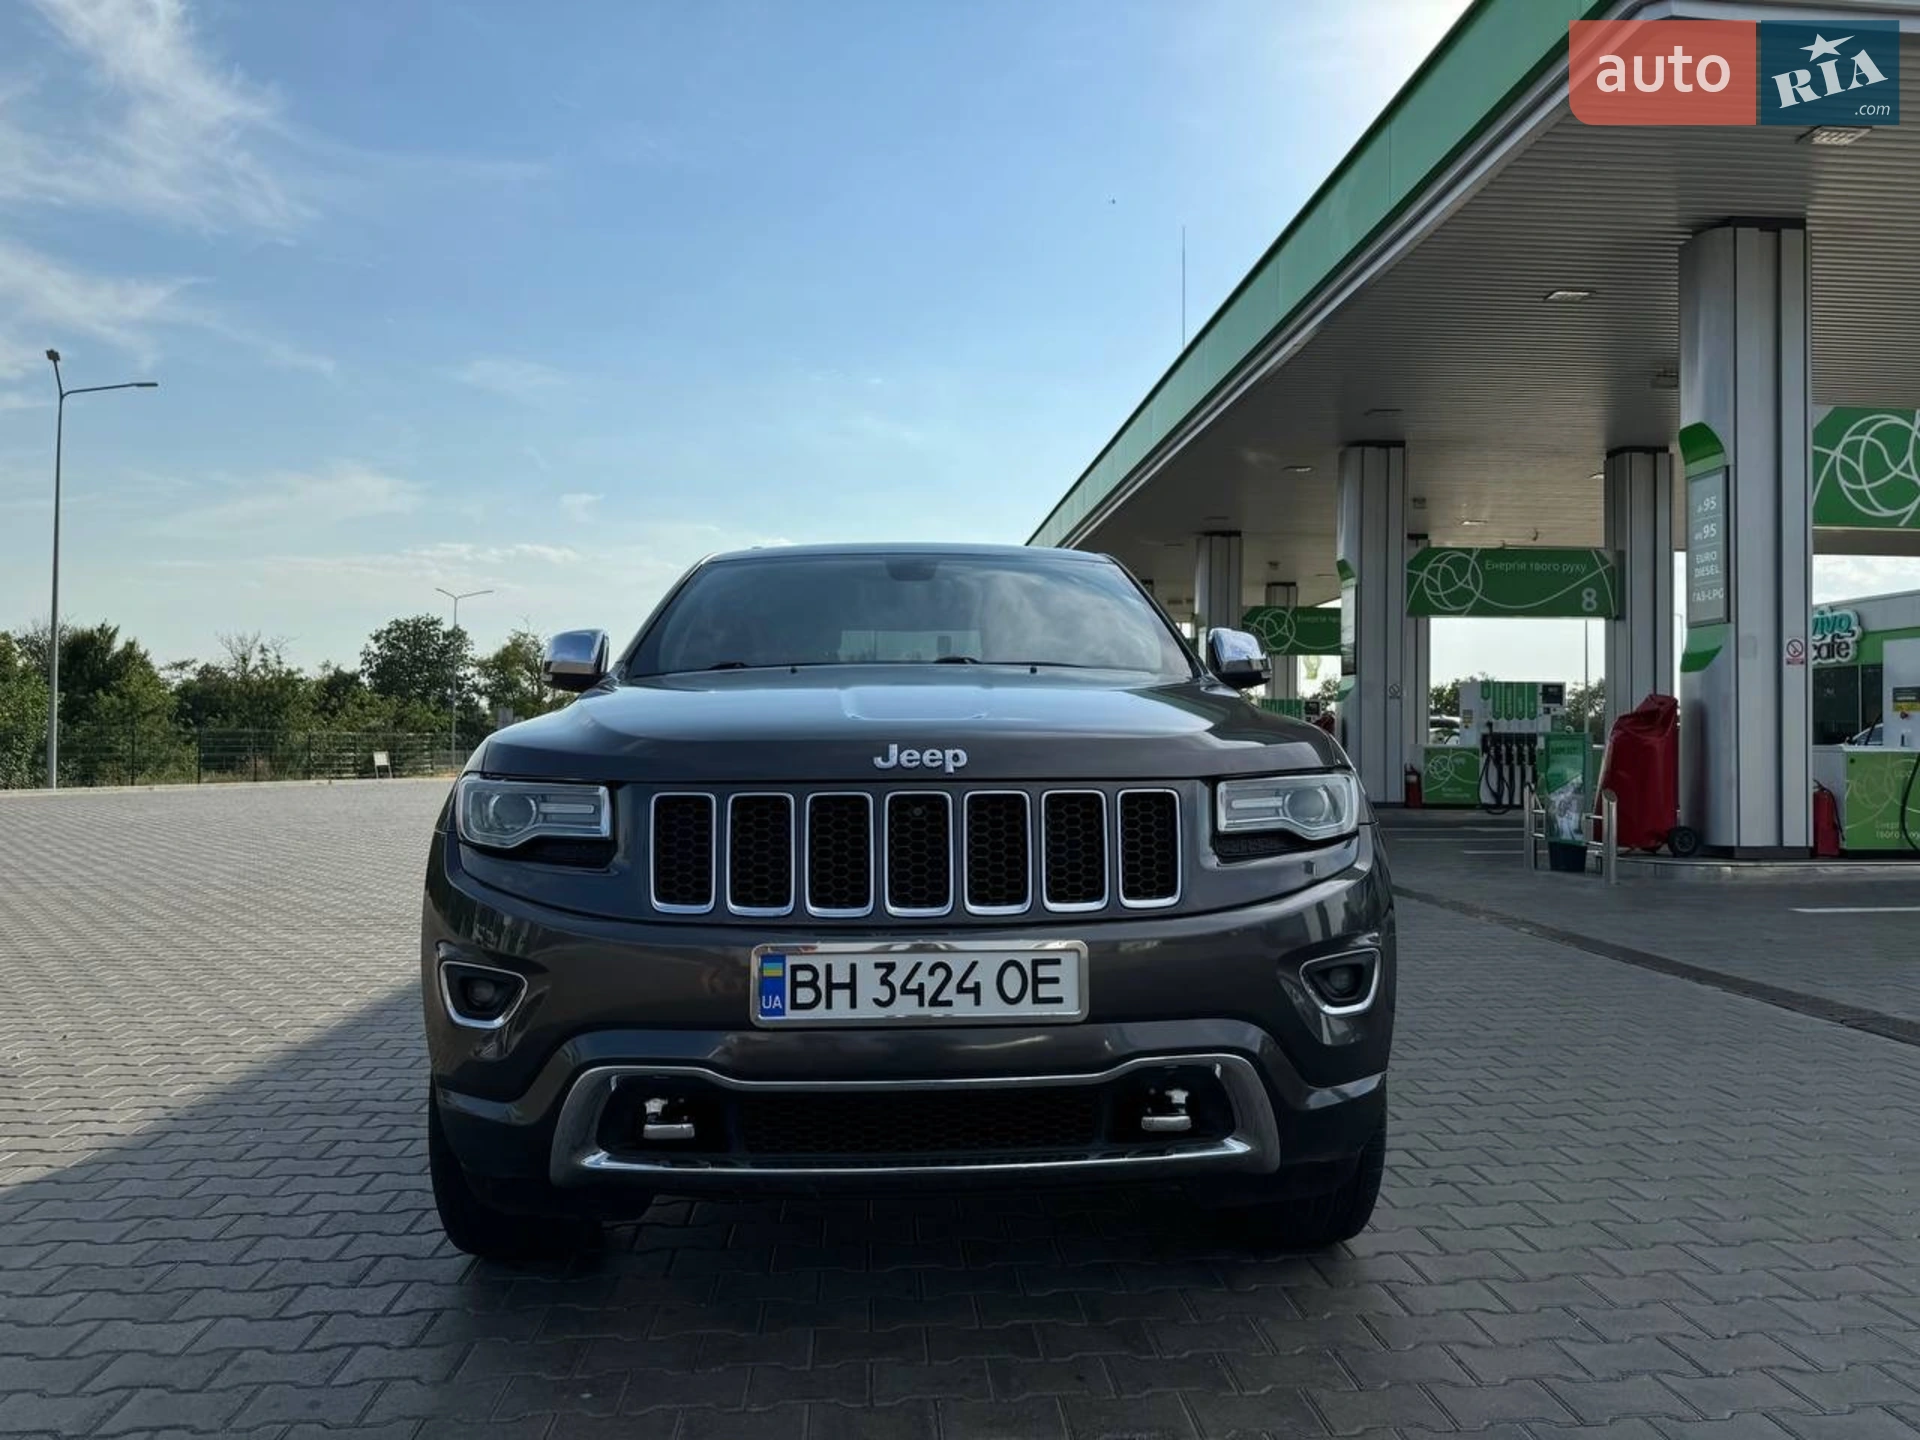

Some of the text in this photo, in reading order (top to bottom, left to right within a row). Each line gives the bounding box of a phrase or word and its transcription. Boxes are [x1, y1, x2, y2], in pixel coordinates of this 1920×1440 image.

[1695, 551, 1717, 564] EURO
[1562, 563, 1586, 574] руху
[1694, 564, 1720, 578] DIESEL
[1581, 587, 1597, 612] 8
[873, 743, 968, 774] Jeep
[789, 958, 1064, 1010] BH 3424 OE
[761, 995, 782, 1009] UA
